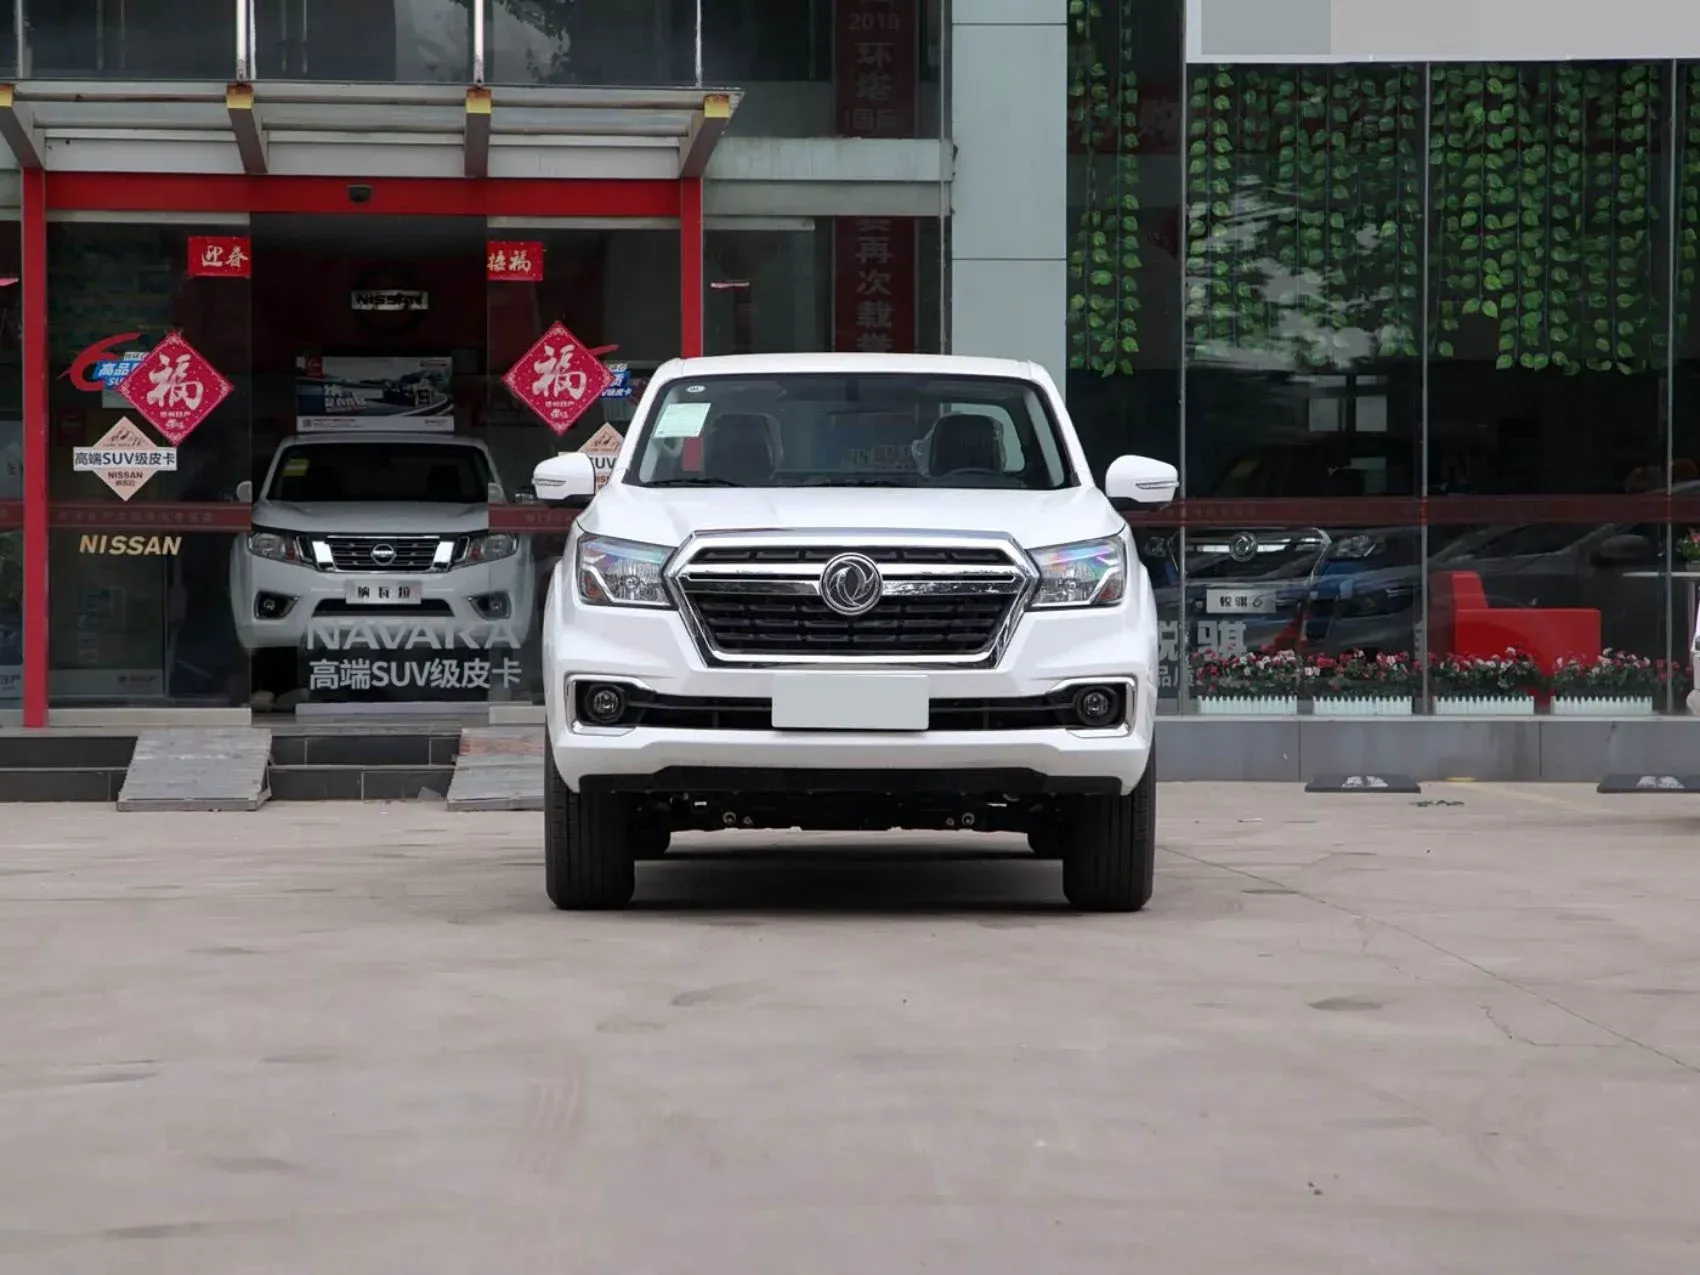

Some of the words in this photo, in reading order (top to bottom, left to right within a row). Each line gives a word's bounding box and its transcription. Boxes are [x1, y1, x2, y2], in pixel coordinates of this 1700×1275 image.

[201, 245, 249, 267] 迎春
[146, 353, 204, 410] 福
[531, 344, 588, 401] 福
[74, 452, 176, 466] 高端SUV级皮卡
[108, 471, 143, 479] NISSAN
[79, 534, 182, 555] NISSAN
[306, 621, 521, 650] NAVARA
[309, 658, 523, 690] 高端SUV级皮卡
